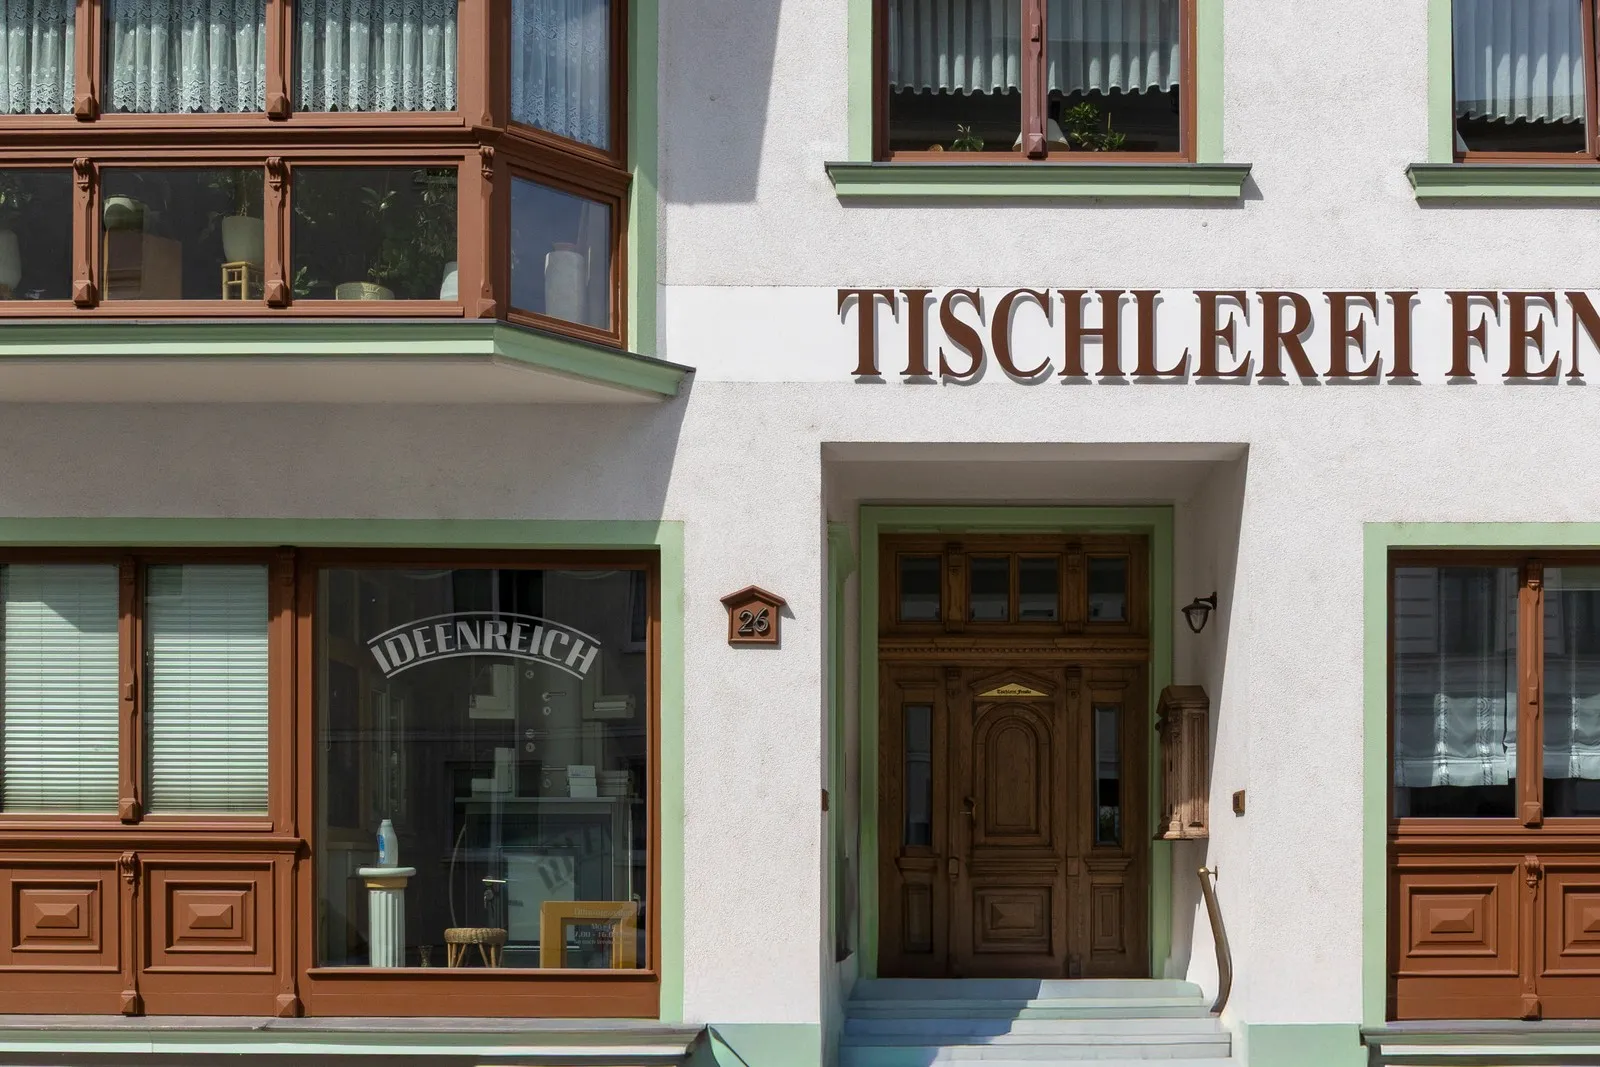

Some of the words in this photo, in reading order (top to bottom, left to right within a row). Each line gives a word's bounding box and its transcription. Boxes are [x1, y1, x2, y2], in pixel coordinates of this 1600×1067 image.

[837, 288, 1419, 378] TISCHLEREI
[370, 620, 599, 674] IDEENREICH
[738, 607, 770, 633] 26
